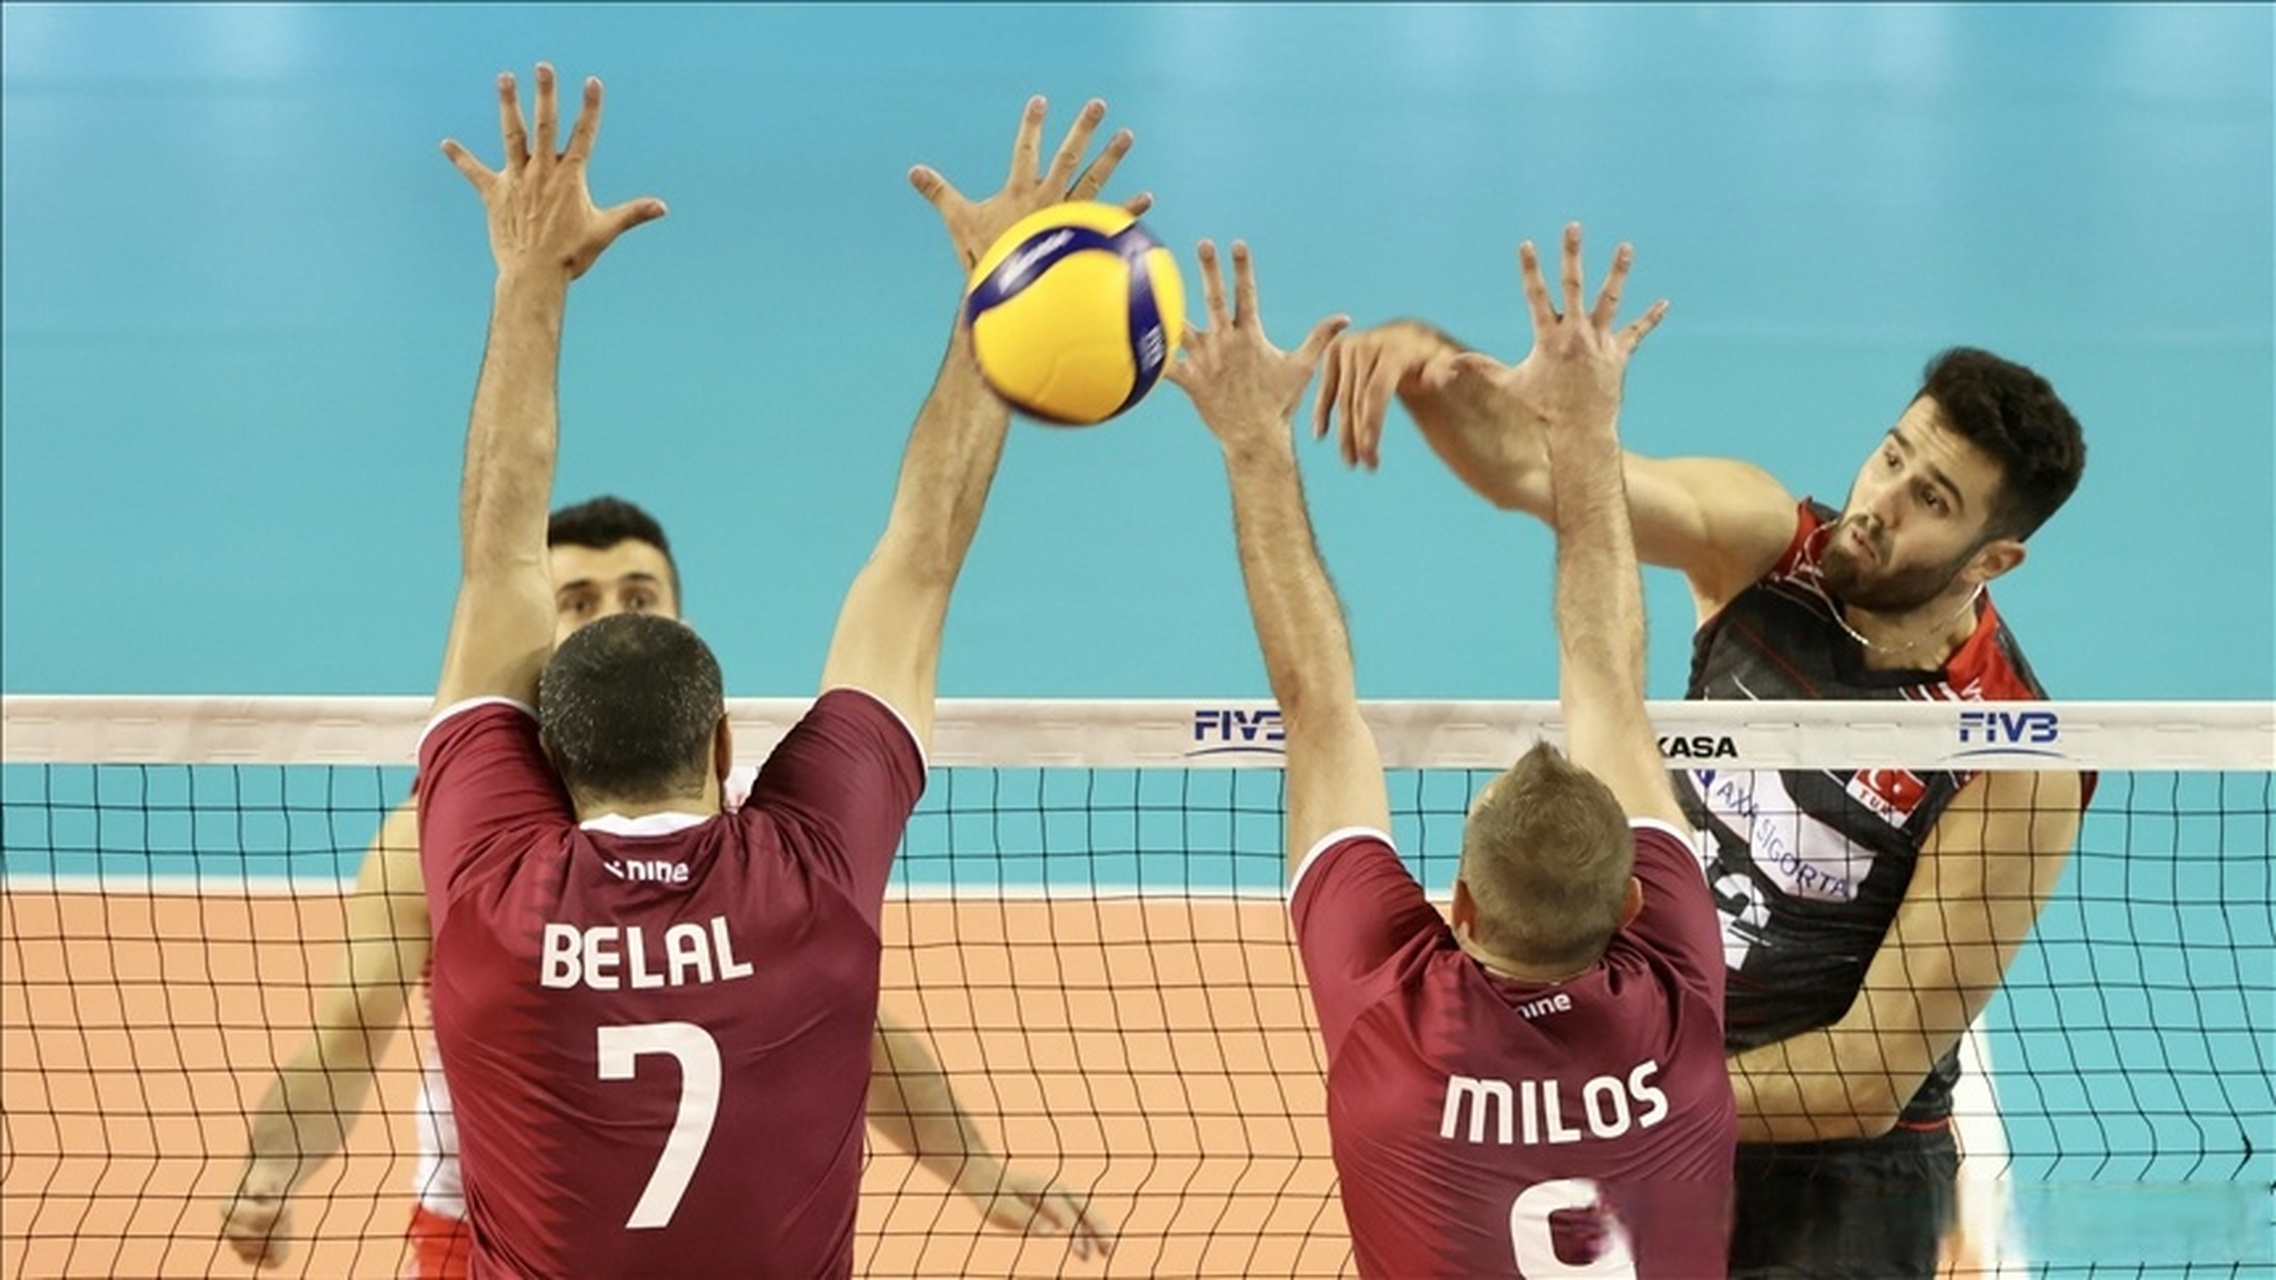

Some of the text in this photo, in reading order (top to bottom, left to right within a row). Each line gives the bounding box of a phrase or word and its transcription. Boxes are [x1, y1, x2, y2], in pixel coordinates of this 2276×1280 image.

[1959, 711, 2059, 743] FIVB
[1756, 818, 1849, 897] SIGORTA
[540, 916, 755, 990] BELAL
[597, 1021, 722, 1229] 7
[1440, 1059, 1670, 1144] MILOS
